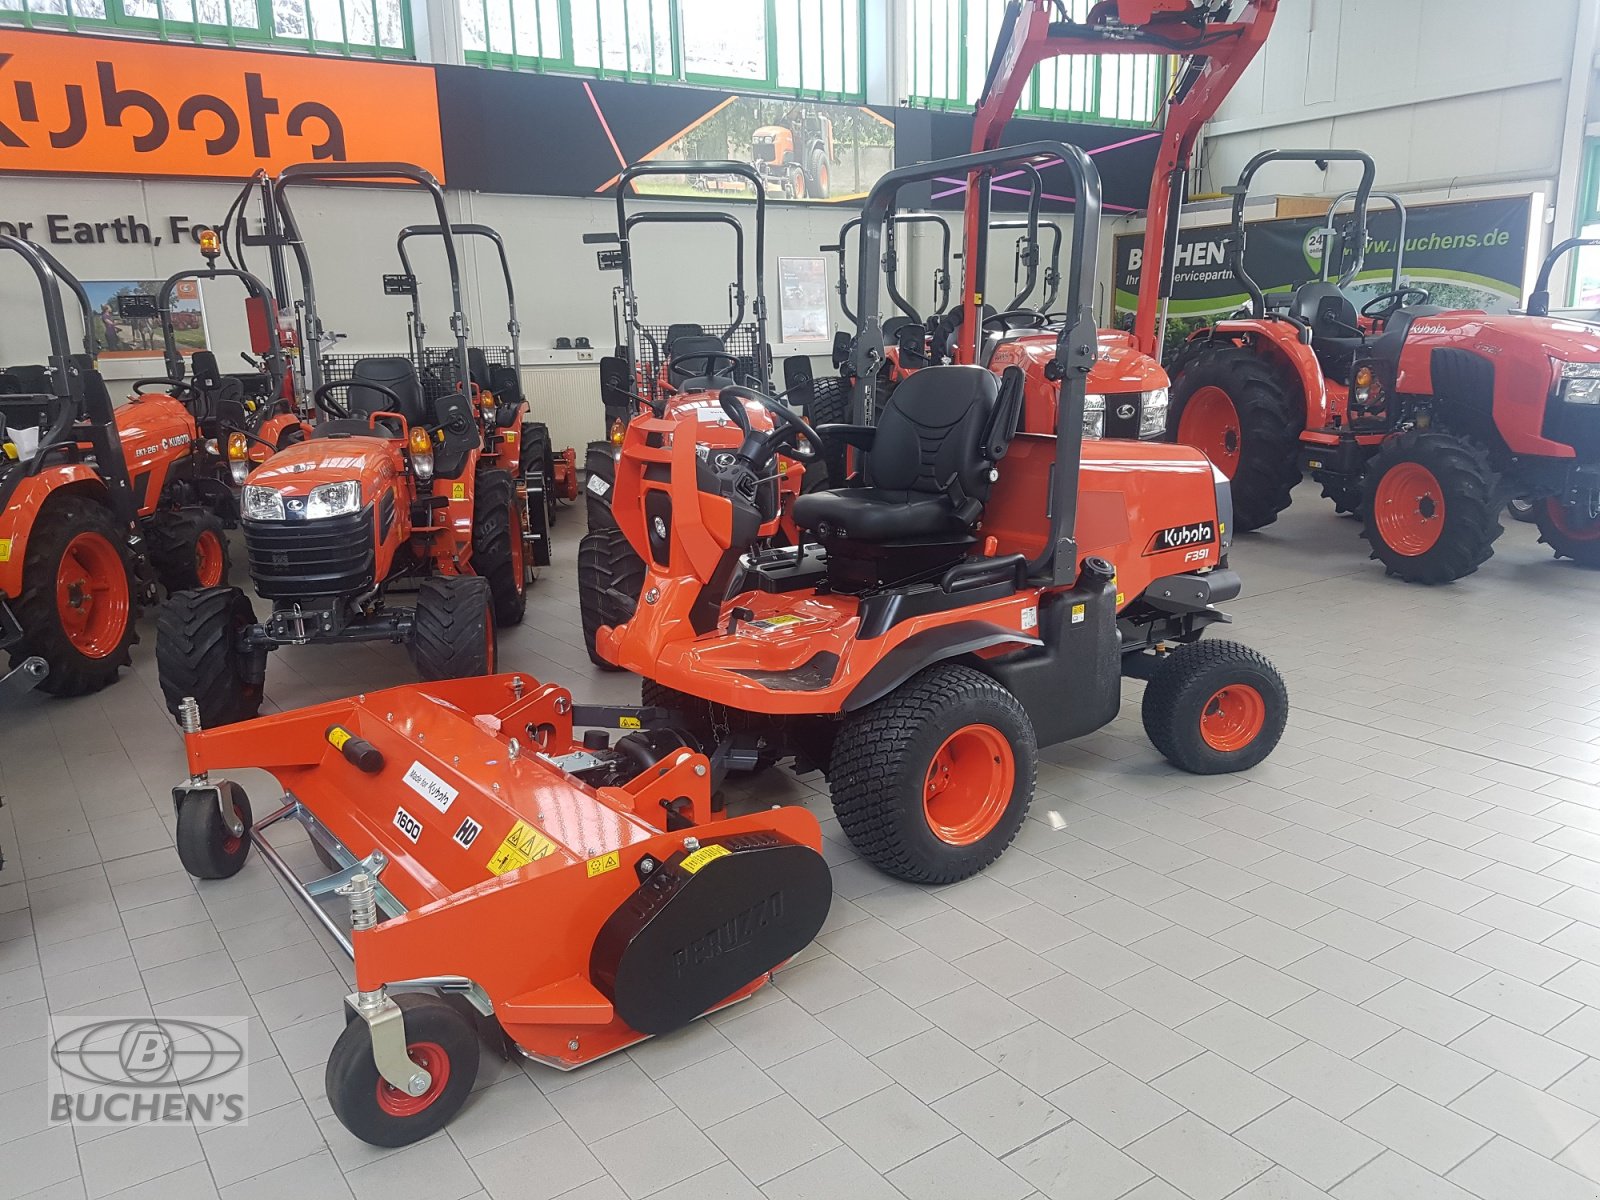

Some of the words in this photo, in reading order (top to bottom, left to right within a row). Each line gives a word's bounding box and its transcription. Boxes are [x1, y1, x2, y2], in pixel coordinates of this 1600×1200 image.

[46, 214, 162, 246] Earth,
[1127, 241, 1226, 271] BHEN
[1126, 274, 1140, 286] Ihr
[1173, 268, 1236, 283] ervicepartn
[1410, 323, 1447, 334] Kubota
[168, 433, 192, 448] KUBOTA
[1164, 523, 1211, 547] Kubota
[1184, 548, 1209, 563] F391
[409, 769, 422, 784] Made
[421, 777, 429, 788] for
[427, 781, 449, 806] Kubota
[396, 810, 420, 840] 1600
[455, 818, 479, 846] HD
[673, 890, 784, 979] PERUZZO
